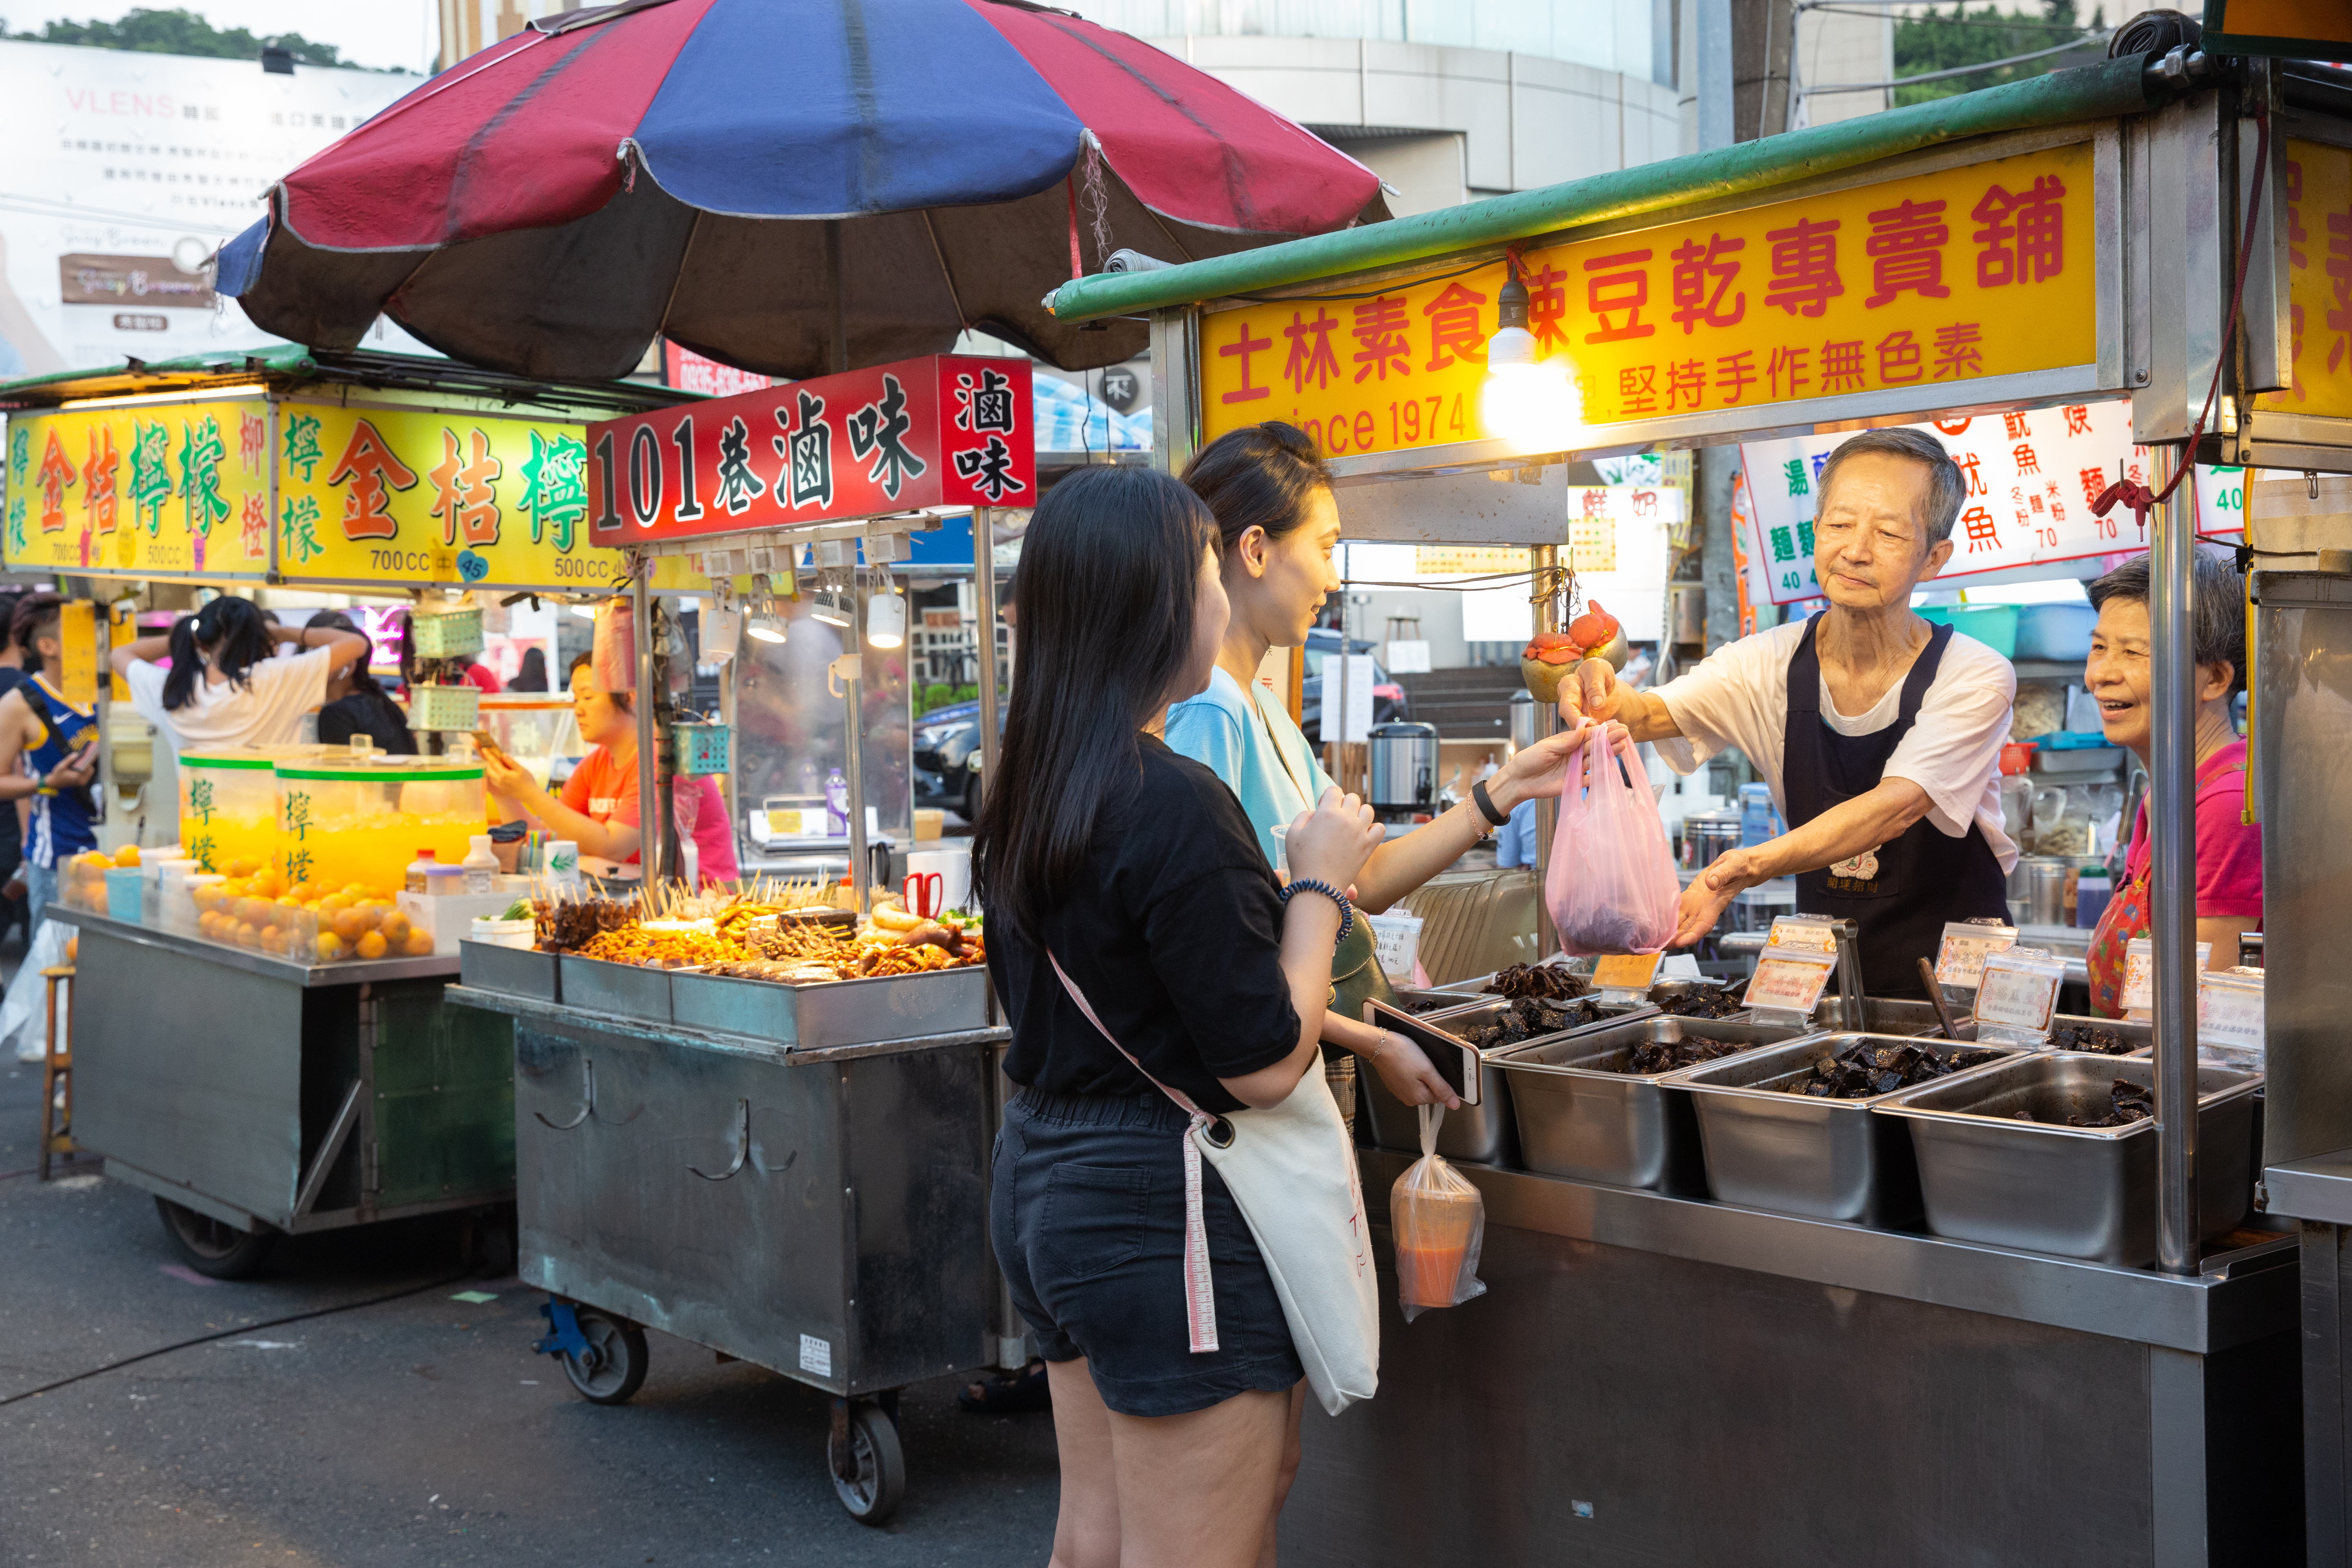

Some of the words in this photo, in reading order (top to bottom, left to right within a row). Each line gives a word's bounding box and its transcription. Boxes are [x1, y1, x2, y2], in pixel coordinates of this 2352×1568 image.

[66, 87, 175, 119] VLENS
[1389, 392, 1467, 445] 1974
[952, 367, 1027, 503] 滷味
[593, 372, 928, 532] 101巷滷味
[36, 412, 232, 538] 金桔檸檬
[239, 408, 269, 559] 柳橙
[281, 412, 325, 564] 檸檬
[2216, 488, 2243, 510] 40
[2011, 486, 2030, 527] 冬粉
[2029, 494, 2045, 514] 麵
[2045, 479, 2066, 522] 米粉
[2036, 527, 2057, 548] 70
[2094, 518, 2117, 540] 70
[370, 549, 430, 572] 700CC
[435, 555, 453, 570] 中
[461, 558, 483, 579] 45
[554, 558, 609, 578] 500CC
[1782, 571, 1801, 590] 40
[1827, 877, 1879, 893] 開運招財
[1951, 952, 1985, 966] 沙茶素
